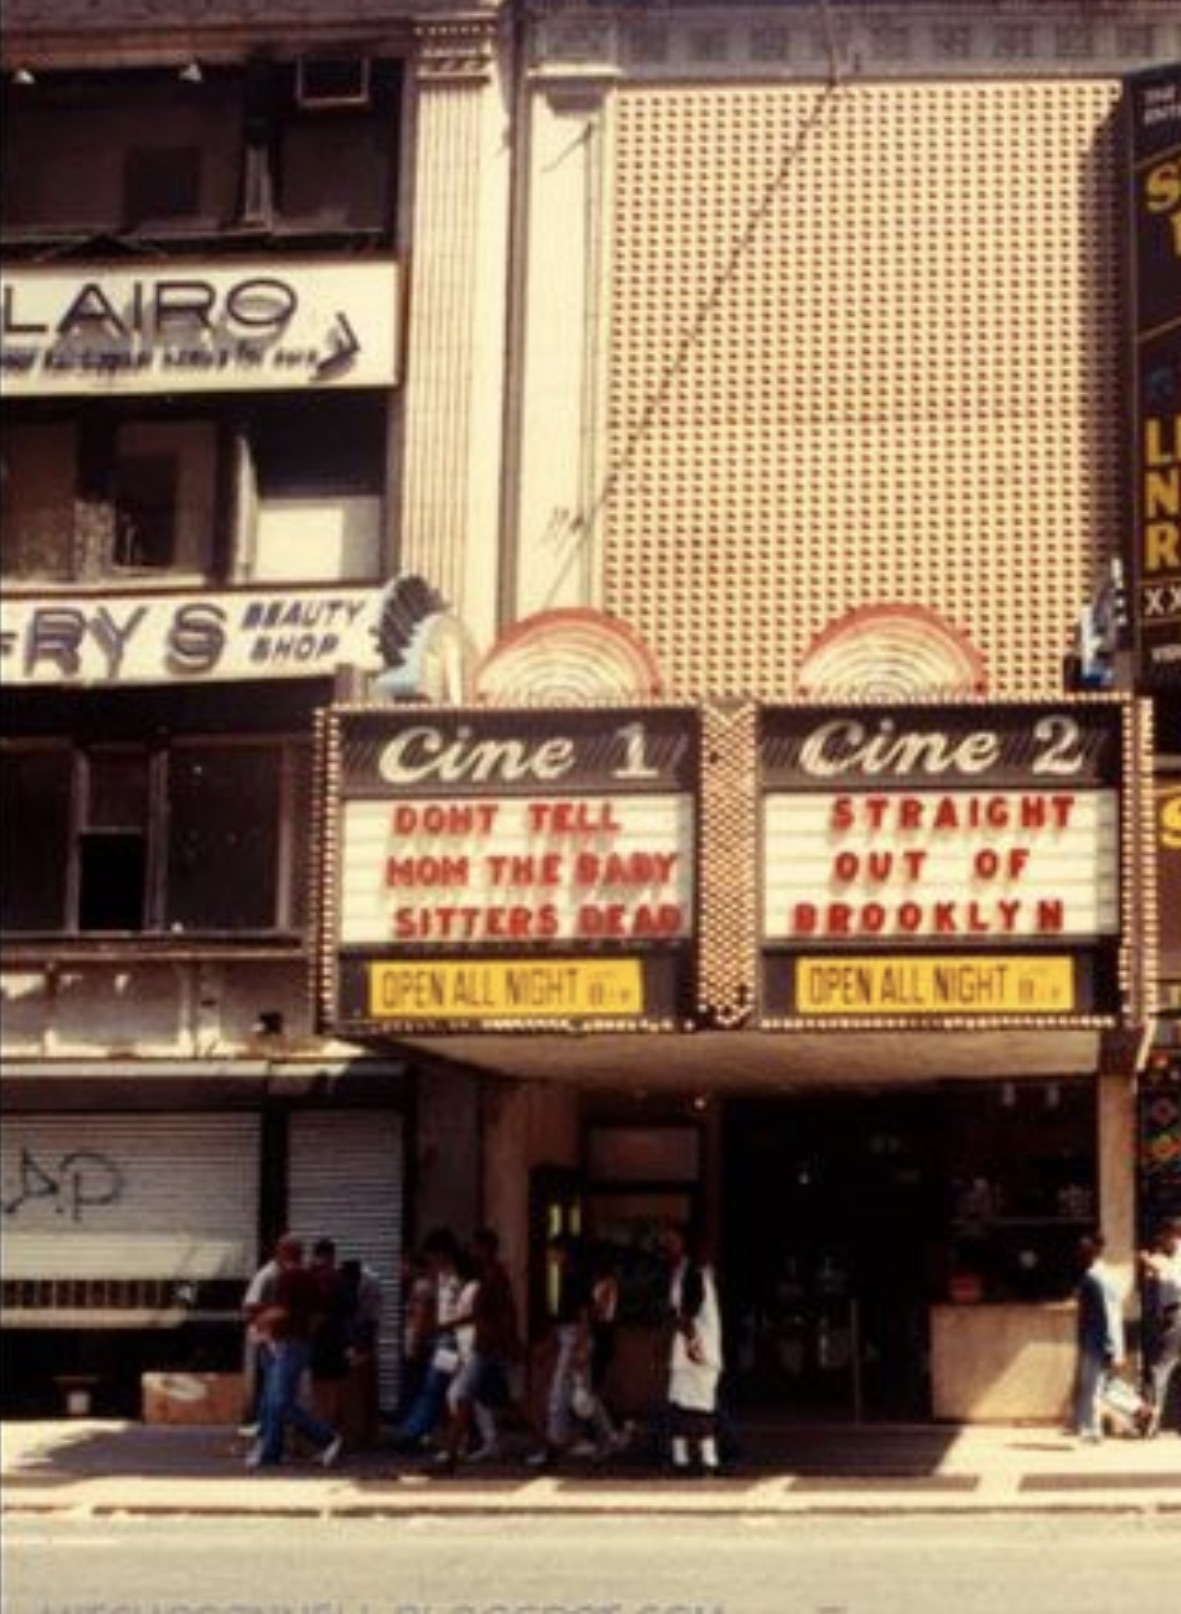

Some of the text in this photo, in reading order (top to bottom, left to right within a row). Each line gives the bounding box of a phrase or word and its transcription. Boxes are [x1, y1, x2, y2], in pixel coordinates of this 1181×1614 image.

[242, 599, 366, 631] BEAUTY
[250, 635, 339, 663] SHOP
[378, 722, 659, 783] Cine 1
[801, 715, 1084, 776] Cine 2
[393, 802, 621, 835] DONT TELL
[831, 796, 1075, 829] STRAIGHT
[386, 852, 677, 887] MOM THE BABY
[834, 848, 1031, 881] OUT OF
[393, 904, 683, 938] SITTERS DEAD
[792, 900, 1064, 936] BROOKLYN
[382, 969, 446, 1009] OPEN
[453, 968, 495, 1007] ALL
[505, 967, 578, 1006] NIGHT
[810, 966, 871, 1005] OPEN
[880, 965, 922, 1004] ALL
[932, 965, 1008, 1004] NIGHT
